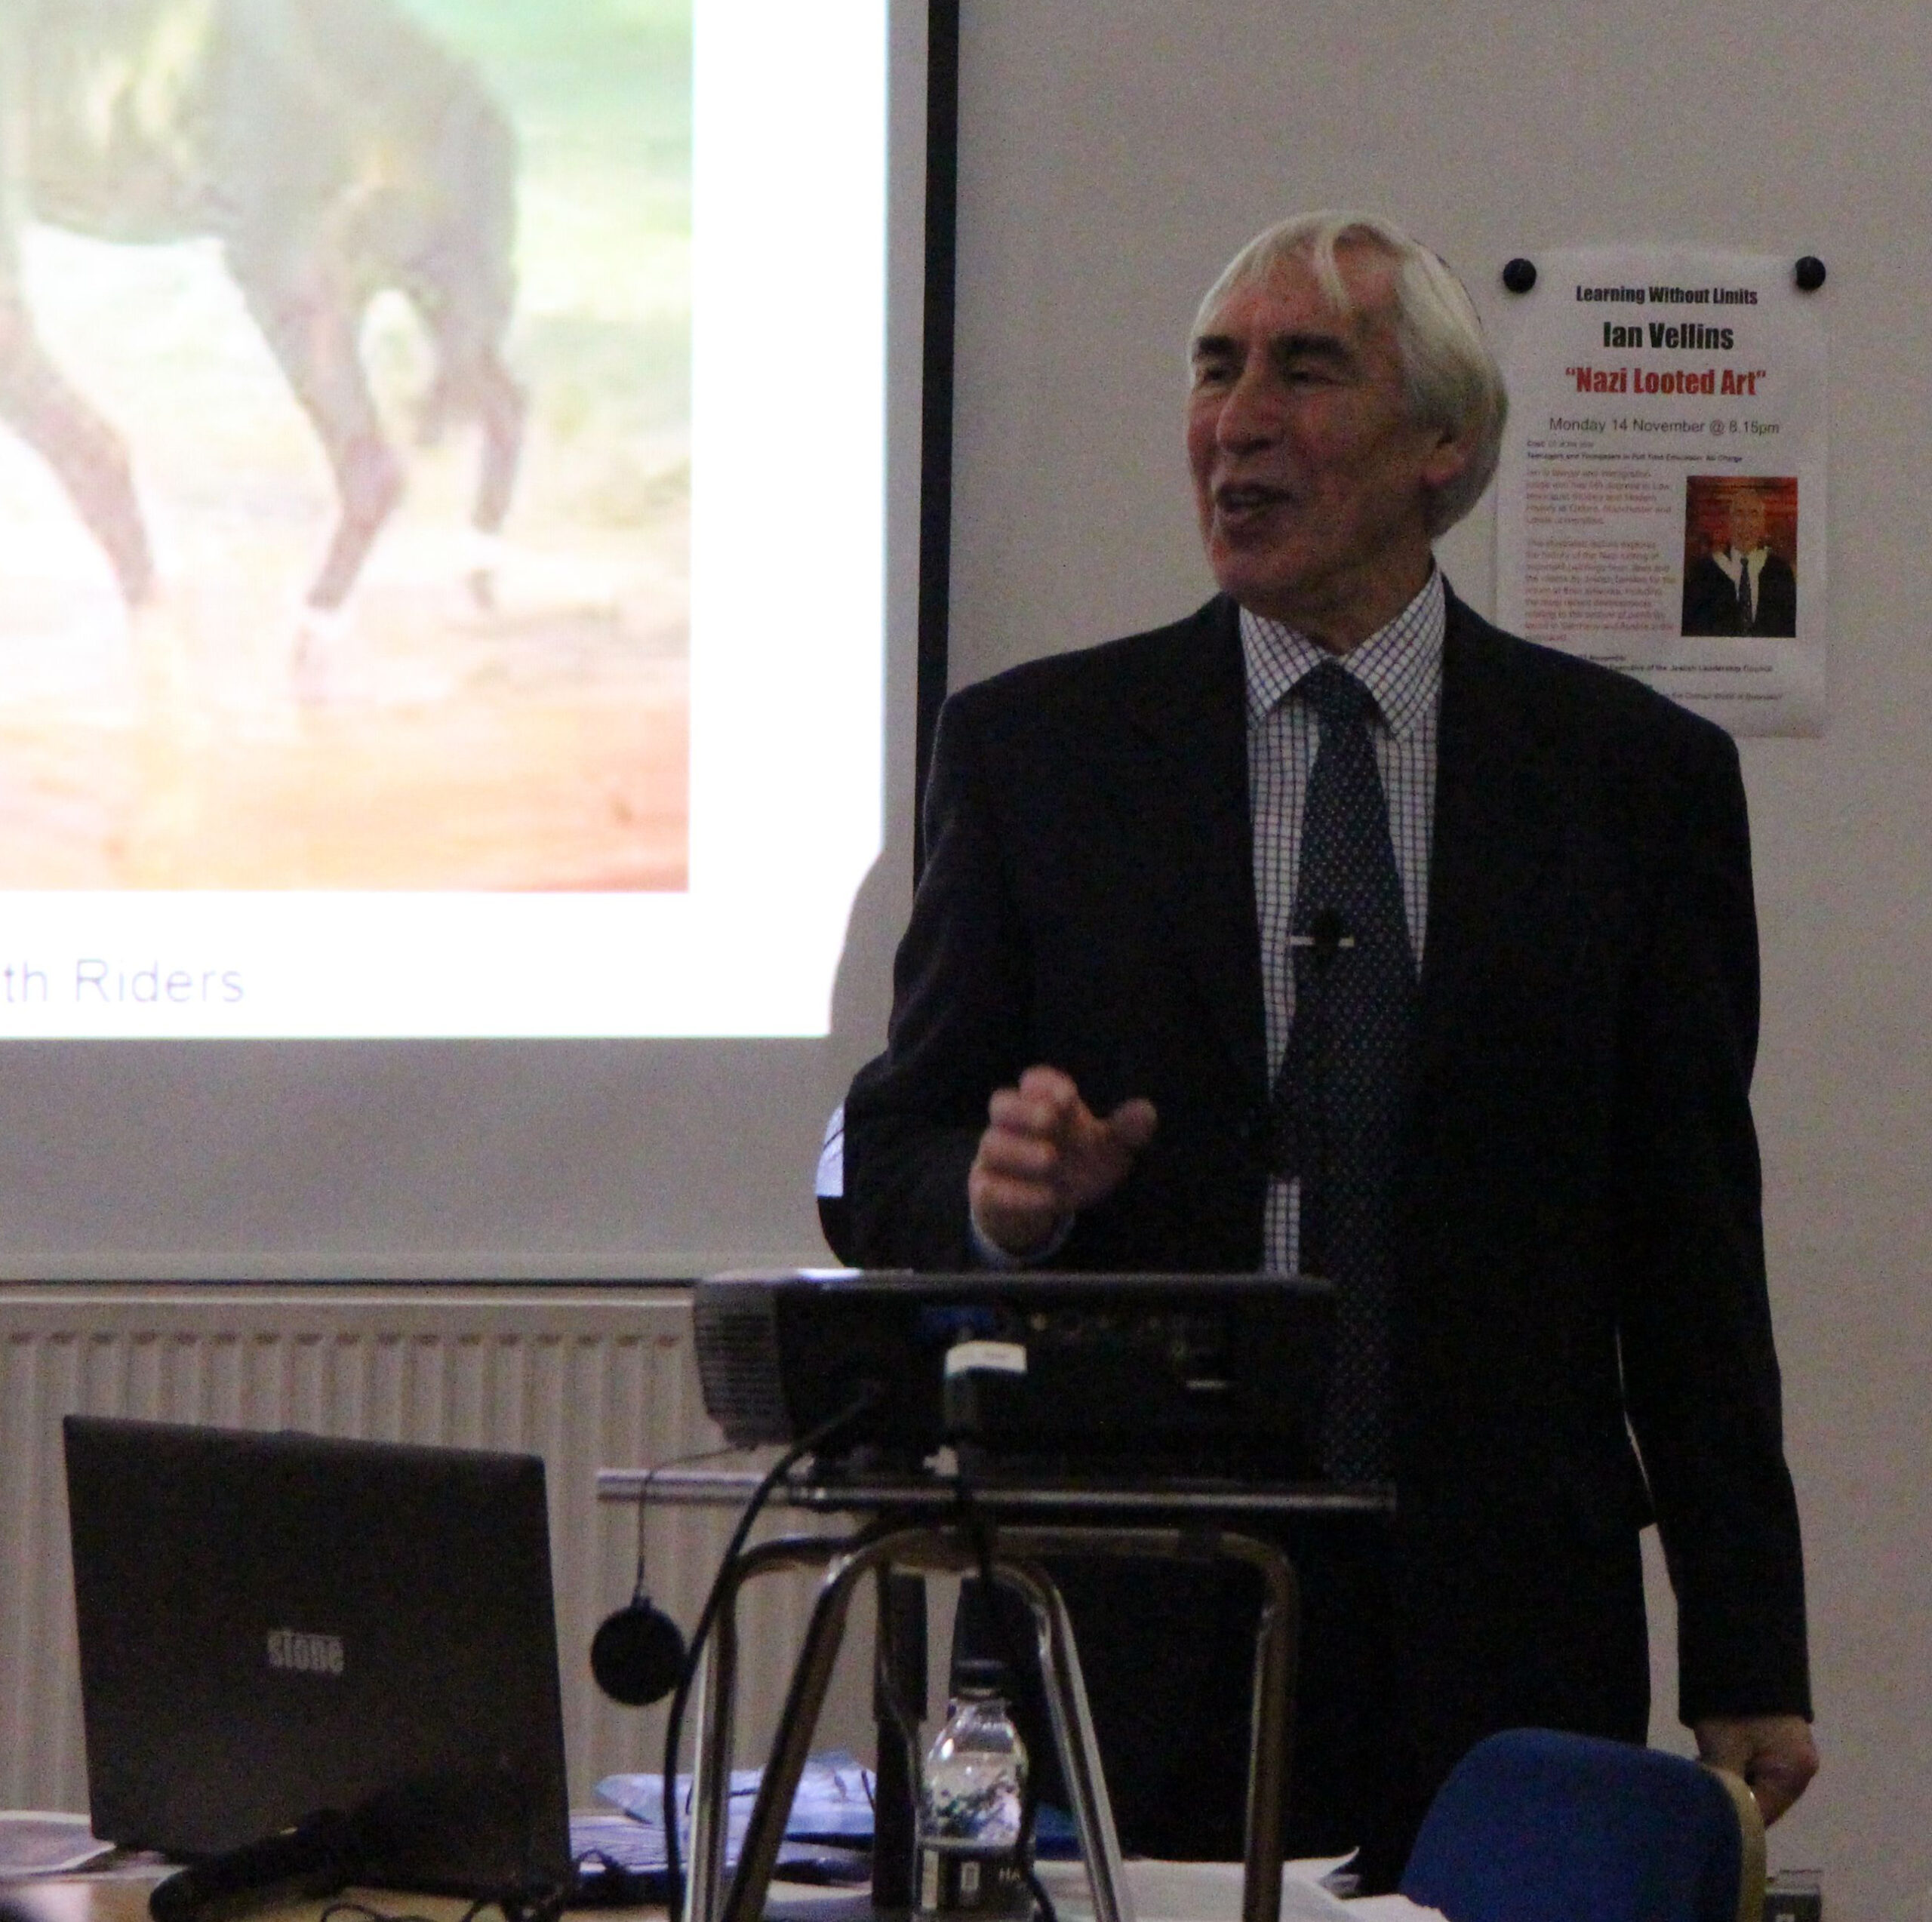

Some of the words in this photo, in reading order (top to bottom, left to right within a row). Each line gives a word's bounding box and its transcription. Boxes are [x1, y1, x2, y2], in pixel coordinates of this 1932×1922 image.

[1577, 285, 1644, 305] Learning
[1649, 286, 1709, 304] Without
[1712, 287, 1758, 305] Limits
[1603, 321, 1643, 347] Ian
[1649, 322, 1734, 350] Vellins
[1634, 368, 1715, 395] Looted
[1549, 417, 1605, 435] Monday
[1613, 418, 1627, 431] 14
[1633, 418, 1705, 433] November
[1709, 420, 1724, 435] @
[76, 958, 244, 1004] Riders
